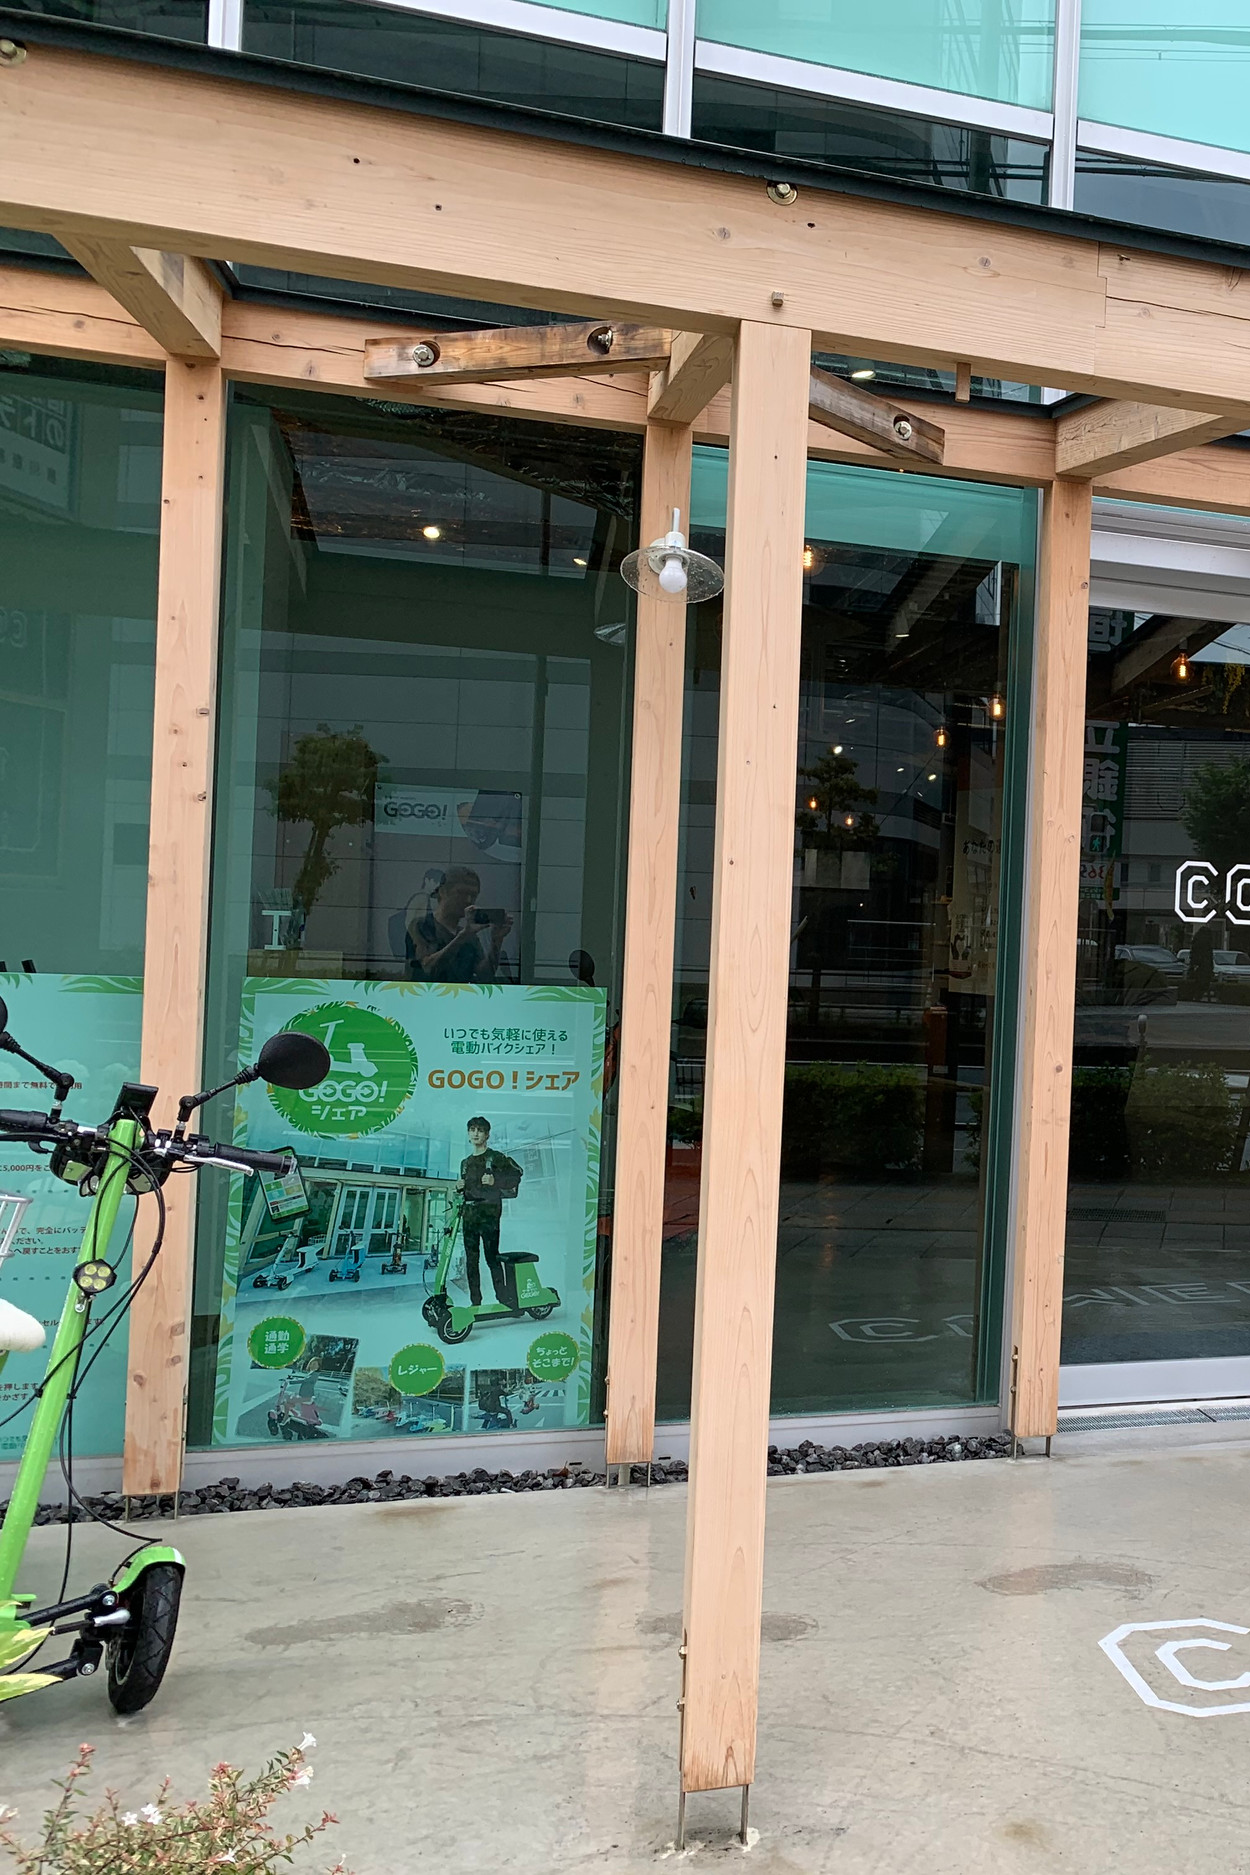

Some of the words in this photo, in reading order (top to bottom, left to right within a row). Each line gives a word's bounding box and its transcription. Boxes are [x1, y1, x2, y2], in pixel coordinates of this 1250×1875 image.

[383, 801, 448, 821] GOGO!
[444, 1027, 568, 1042] いつでも気軽に使える
[298, 1080, 389, 1103] GOGO!
[311, 1105, 367, 1121] シェア
[264, 1342, 289, 1354] 通学
[536, 1346, 568, 1356] ちょっと
[397, 1364, 438, 1376] レジャー
